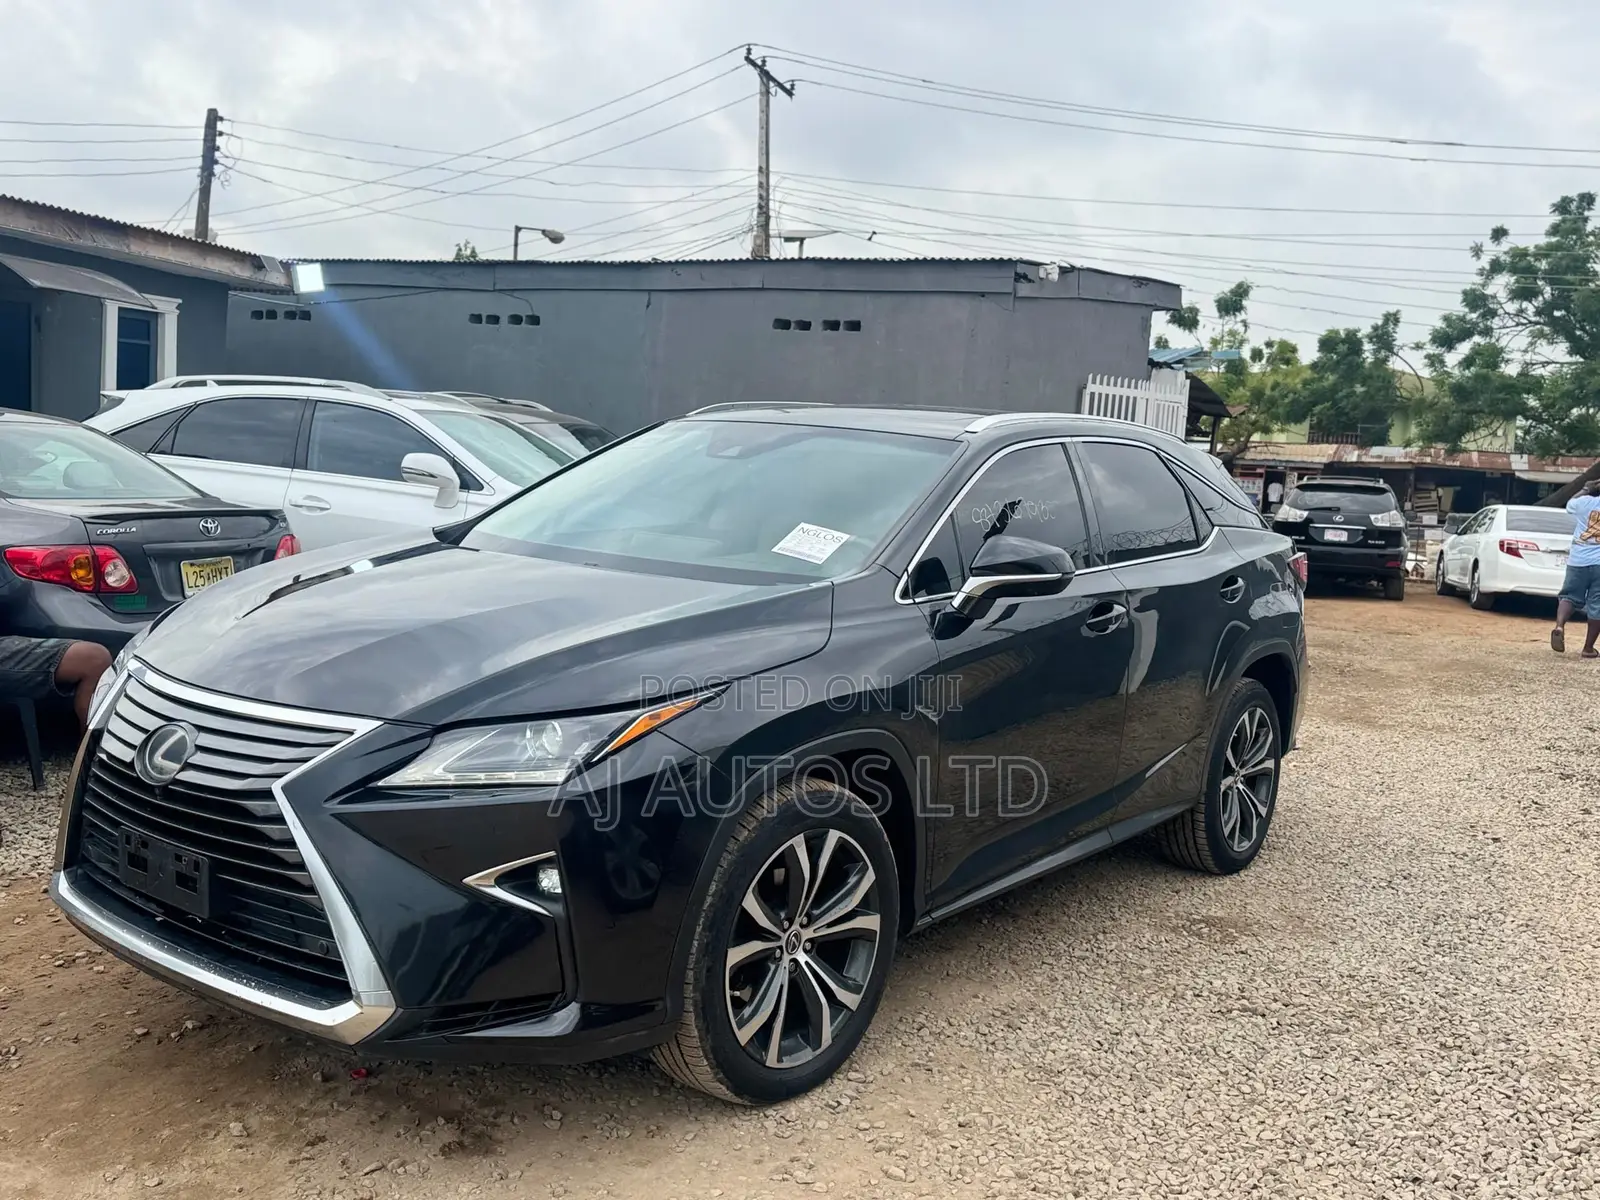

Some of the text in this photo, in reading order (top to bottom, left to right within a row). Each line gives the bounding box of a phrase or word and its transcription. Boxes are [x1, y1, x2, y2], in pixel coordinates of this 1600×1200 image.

[96, 526, 137, 535] COROLLA
[799, 526, 844, 543] NGLOS
[185, 569, 206, 589] L25
